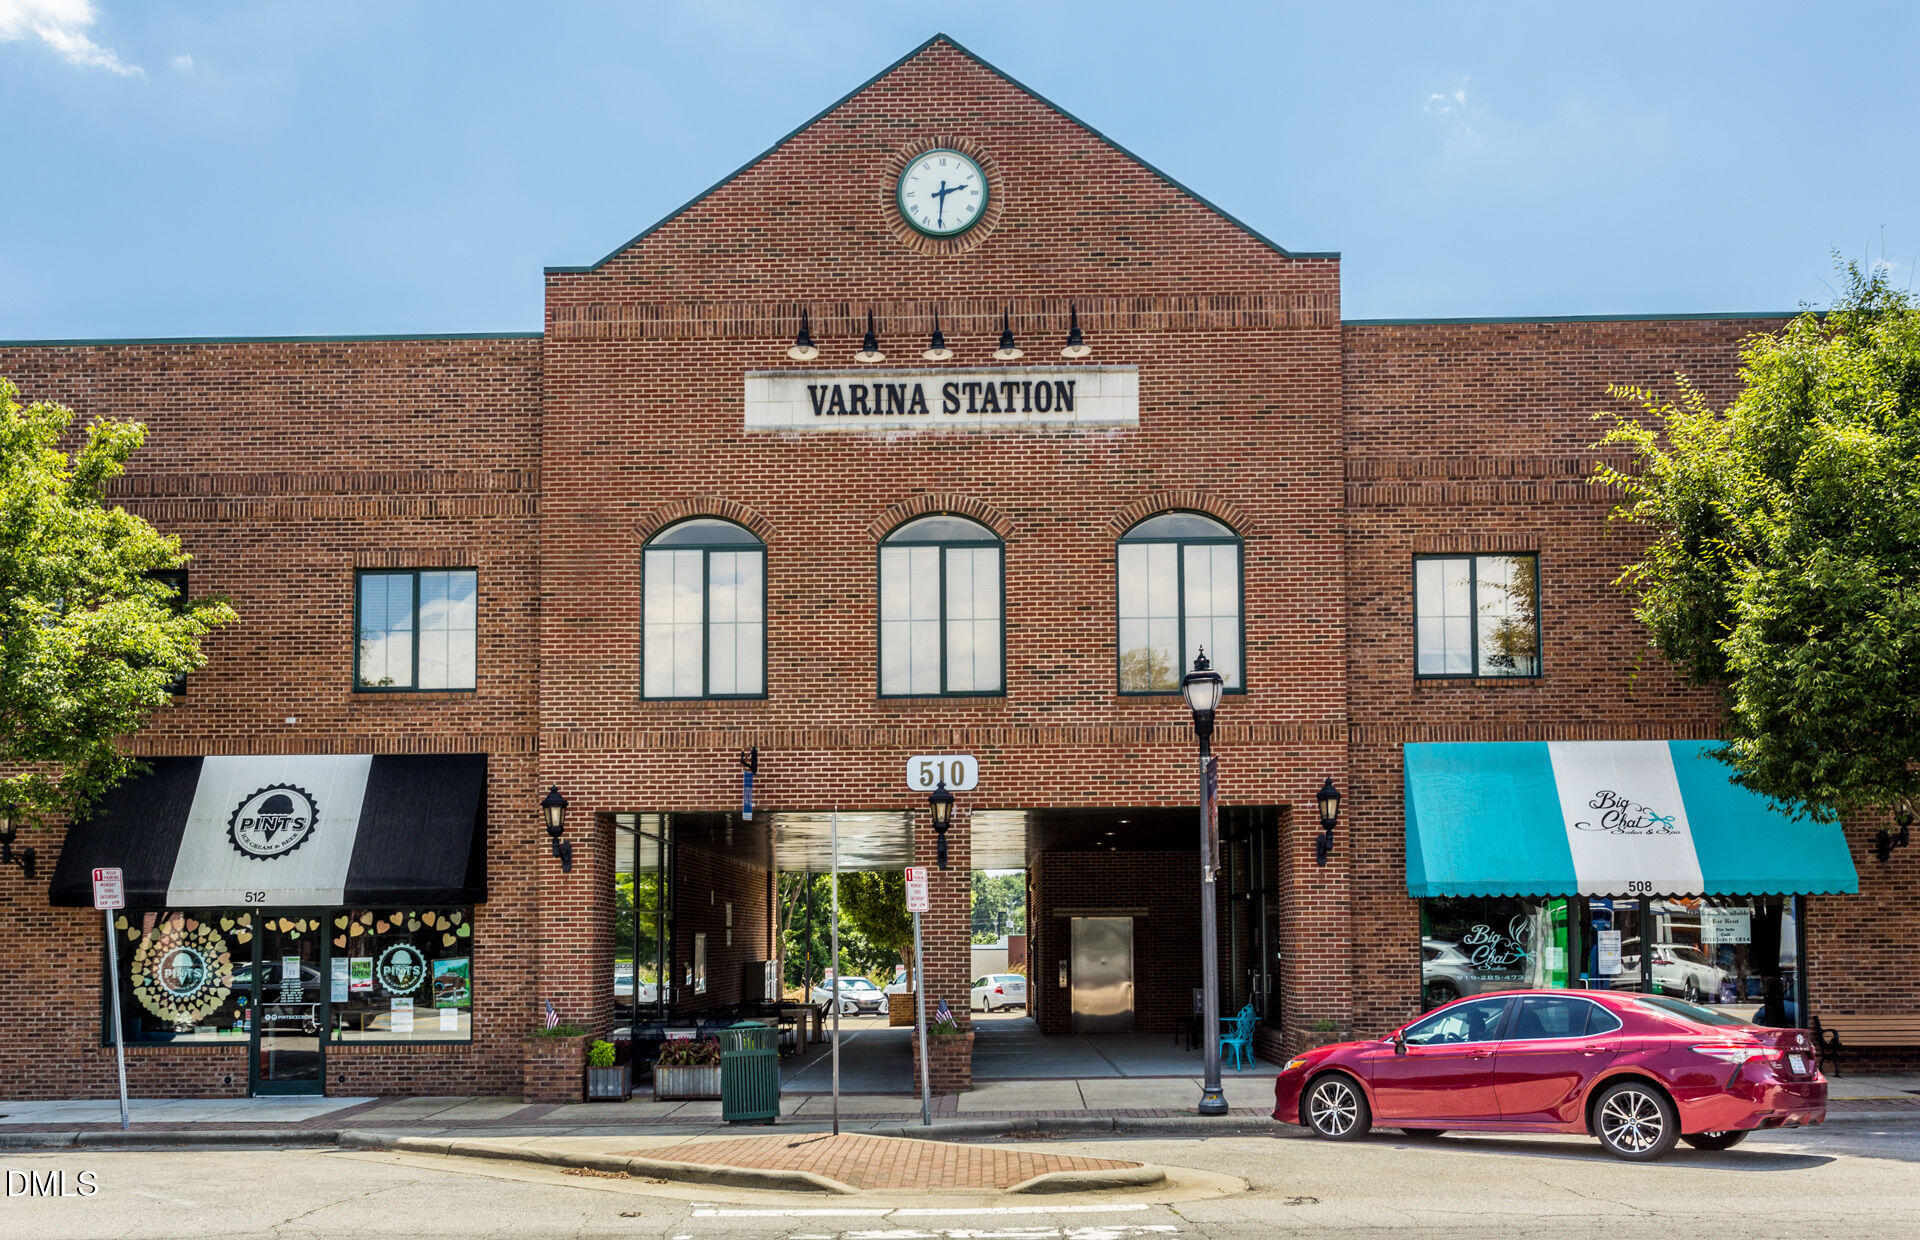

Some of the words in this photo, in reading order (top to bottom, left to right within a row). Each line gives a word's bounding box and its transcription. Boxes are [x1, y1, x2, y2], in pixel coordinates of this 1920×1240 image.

[808, 383, 929, 416] VARINA
[942, 380, 1076, 414] STATION
[920, 760, 964, 787] 510
[1588, 790, 1642, 814] Big
[239, 816, 306, 832] PINTS
[1598, 810, 1655, 830] Chat
[1656, 826, 1681, 836] Spa
[249, 842, 273, 850] CREAM
[281, 832, 298, 846] BEER
[96, 870, 101, 880] 1
[907, 869, 912, 880] 1
[1628, 881, 1652, 892] 508
[245, 891, 266, 903] 512
[1463, 924, 1510, 949] Big
[1471, 945, 1519, 965] Chat
[164, 967, 202, 979] PINTS
[383, 965, 421, 976] PINTS
